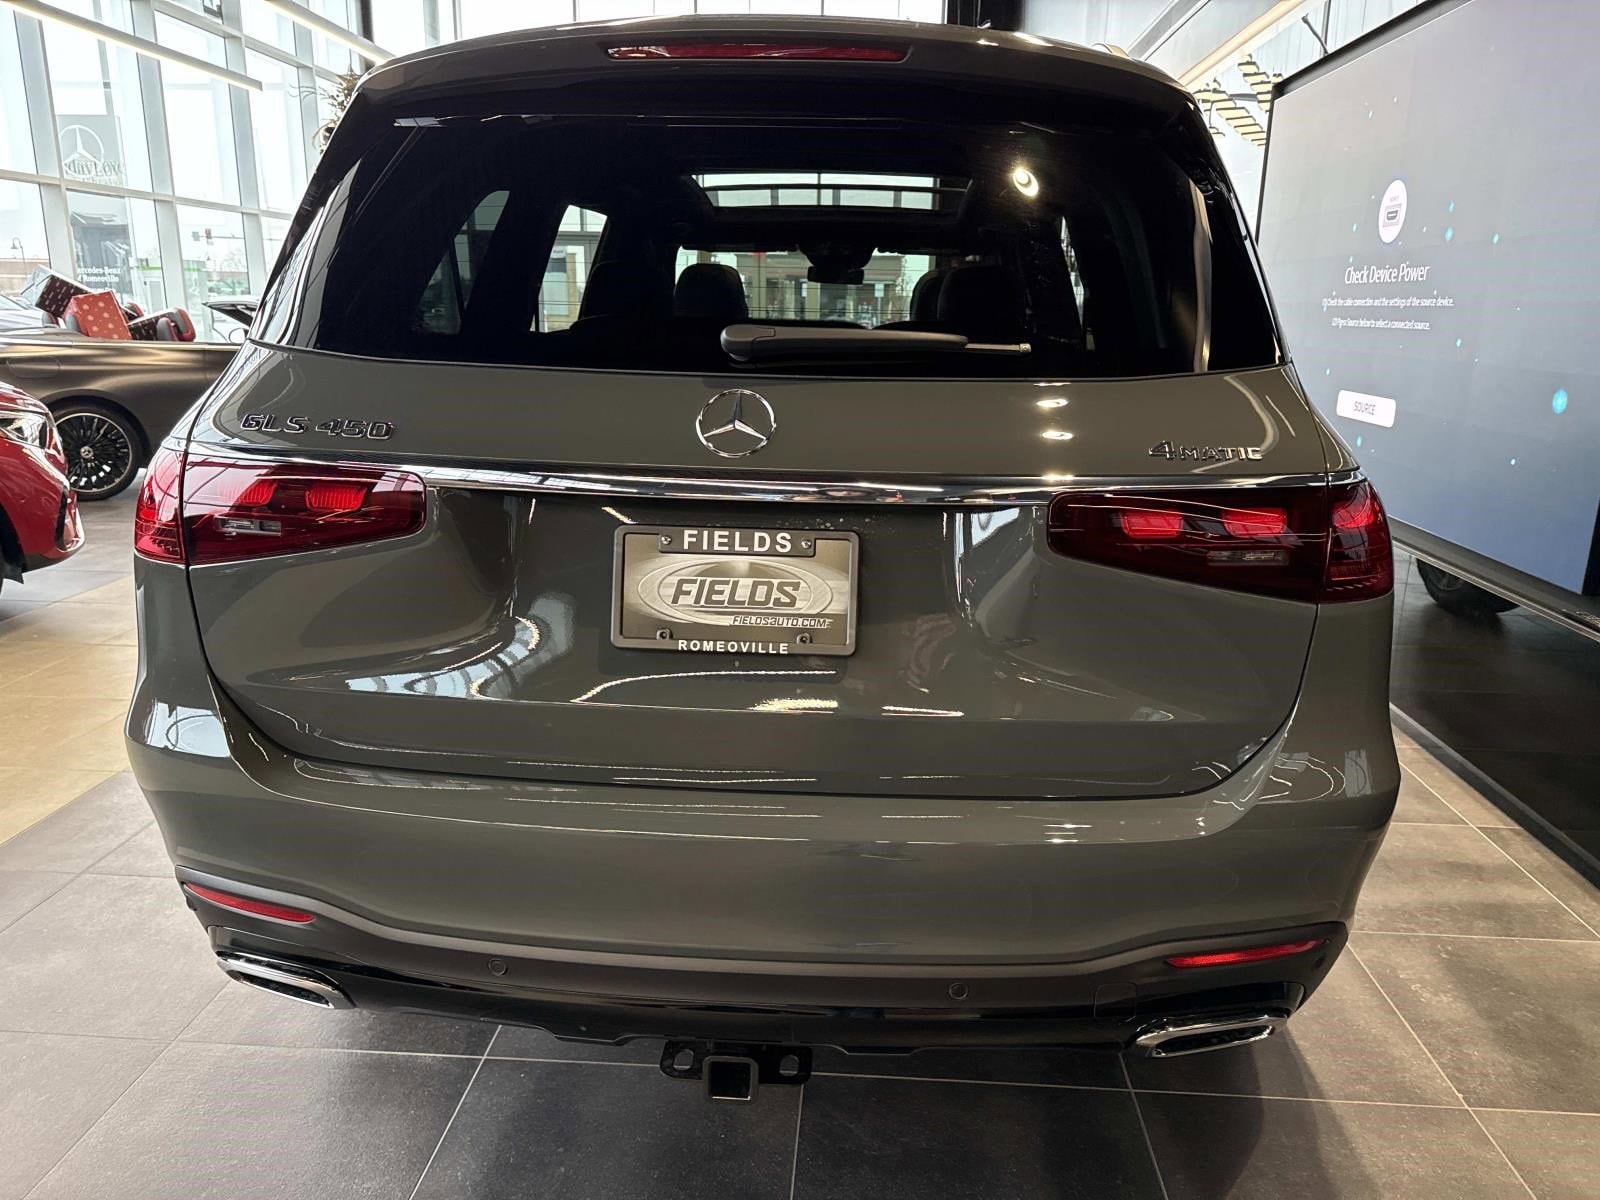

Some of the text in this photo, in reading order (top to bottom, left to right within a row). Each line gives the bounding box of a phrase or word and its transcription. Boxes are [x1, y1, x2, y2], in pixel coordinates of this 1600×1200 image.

[1344, 263, 1430, 284] Check Device Power
[240, 413, 394, 440] GLS 450
[683, 529, 793, 553] FIELDS
[671, 577, 801, 609] FIELDS
[678, 639, 789, 655] ROMEOVILLE
